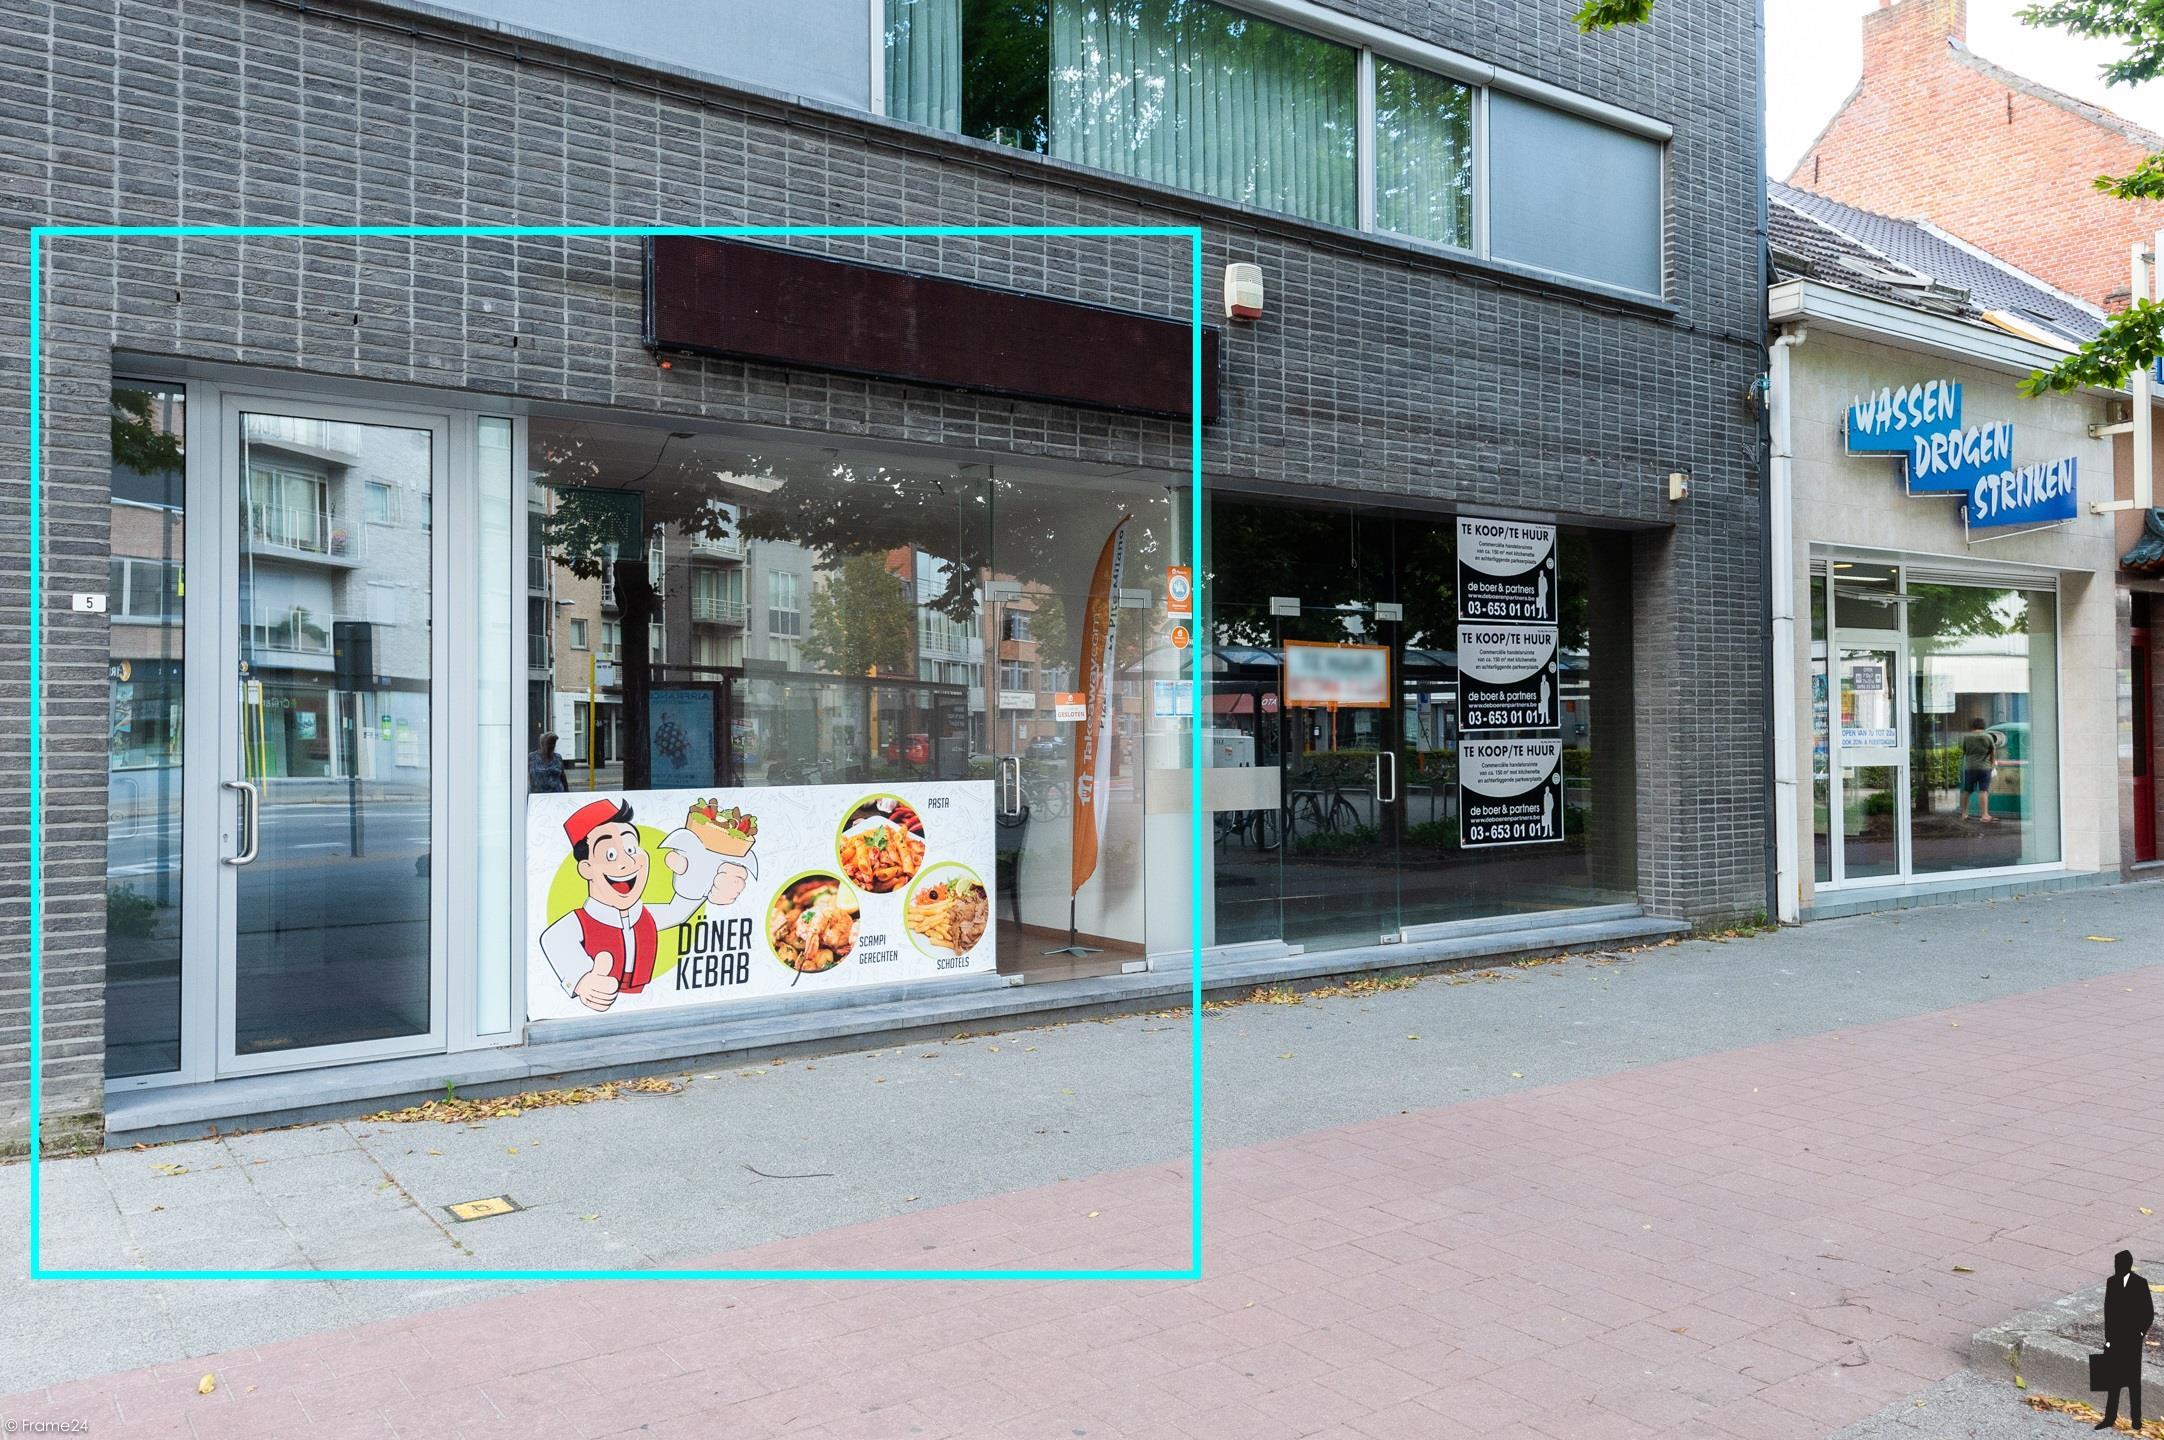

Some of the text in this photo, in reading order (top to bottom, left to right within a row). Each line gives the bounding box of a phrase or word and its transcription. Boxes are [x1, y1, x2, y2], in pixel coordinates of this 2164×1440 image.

[1855, 377, 1956, 436] WASSEN
[1913, 417, 2011, 479] DROGEN
[1974, 456, 2073, 520] STRIJKEN
[1461, 523, 1549, 541] TE KOOP/TE HUUR
[1113, 530, 1124, 588] Milano
[1468, 582, 1535, 594] de boer & partners
[86, 596, 93, 609] 5
[1509, 602, 1521, 617] 01
[1524, 603, 1536, 617] 01
[1462, 632, 1551, 647] TE KOOP/TE HUUR
[1084, 612, 1101, 763] Takeaway.com
[1468, 691, 1537, 702] de boer & partners
[1510, 710, 1523, 725] 01
[1526, 709, 1538, 724] 01
[1842, 729, 1856, 737] OPEN
[1464, 744, 1555, 759] TE KOOP/TE HUUR
[927, 797, 950, 809] PASTA
[1470, 803, 1541, 816] de boer & partners
[1513, 823, 1526, 838] 01
[1529, 823, 1541, 837] 01
[678, 914, 753, 956] DÖNER
[859, 934, 886, 947] SCAMPI
[859, 950, 898, 965] GERECHTEN
[936, 956, 970, 970] SCHOTELS
[676, 952, 750, 991] KEBAB
